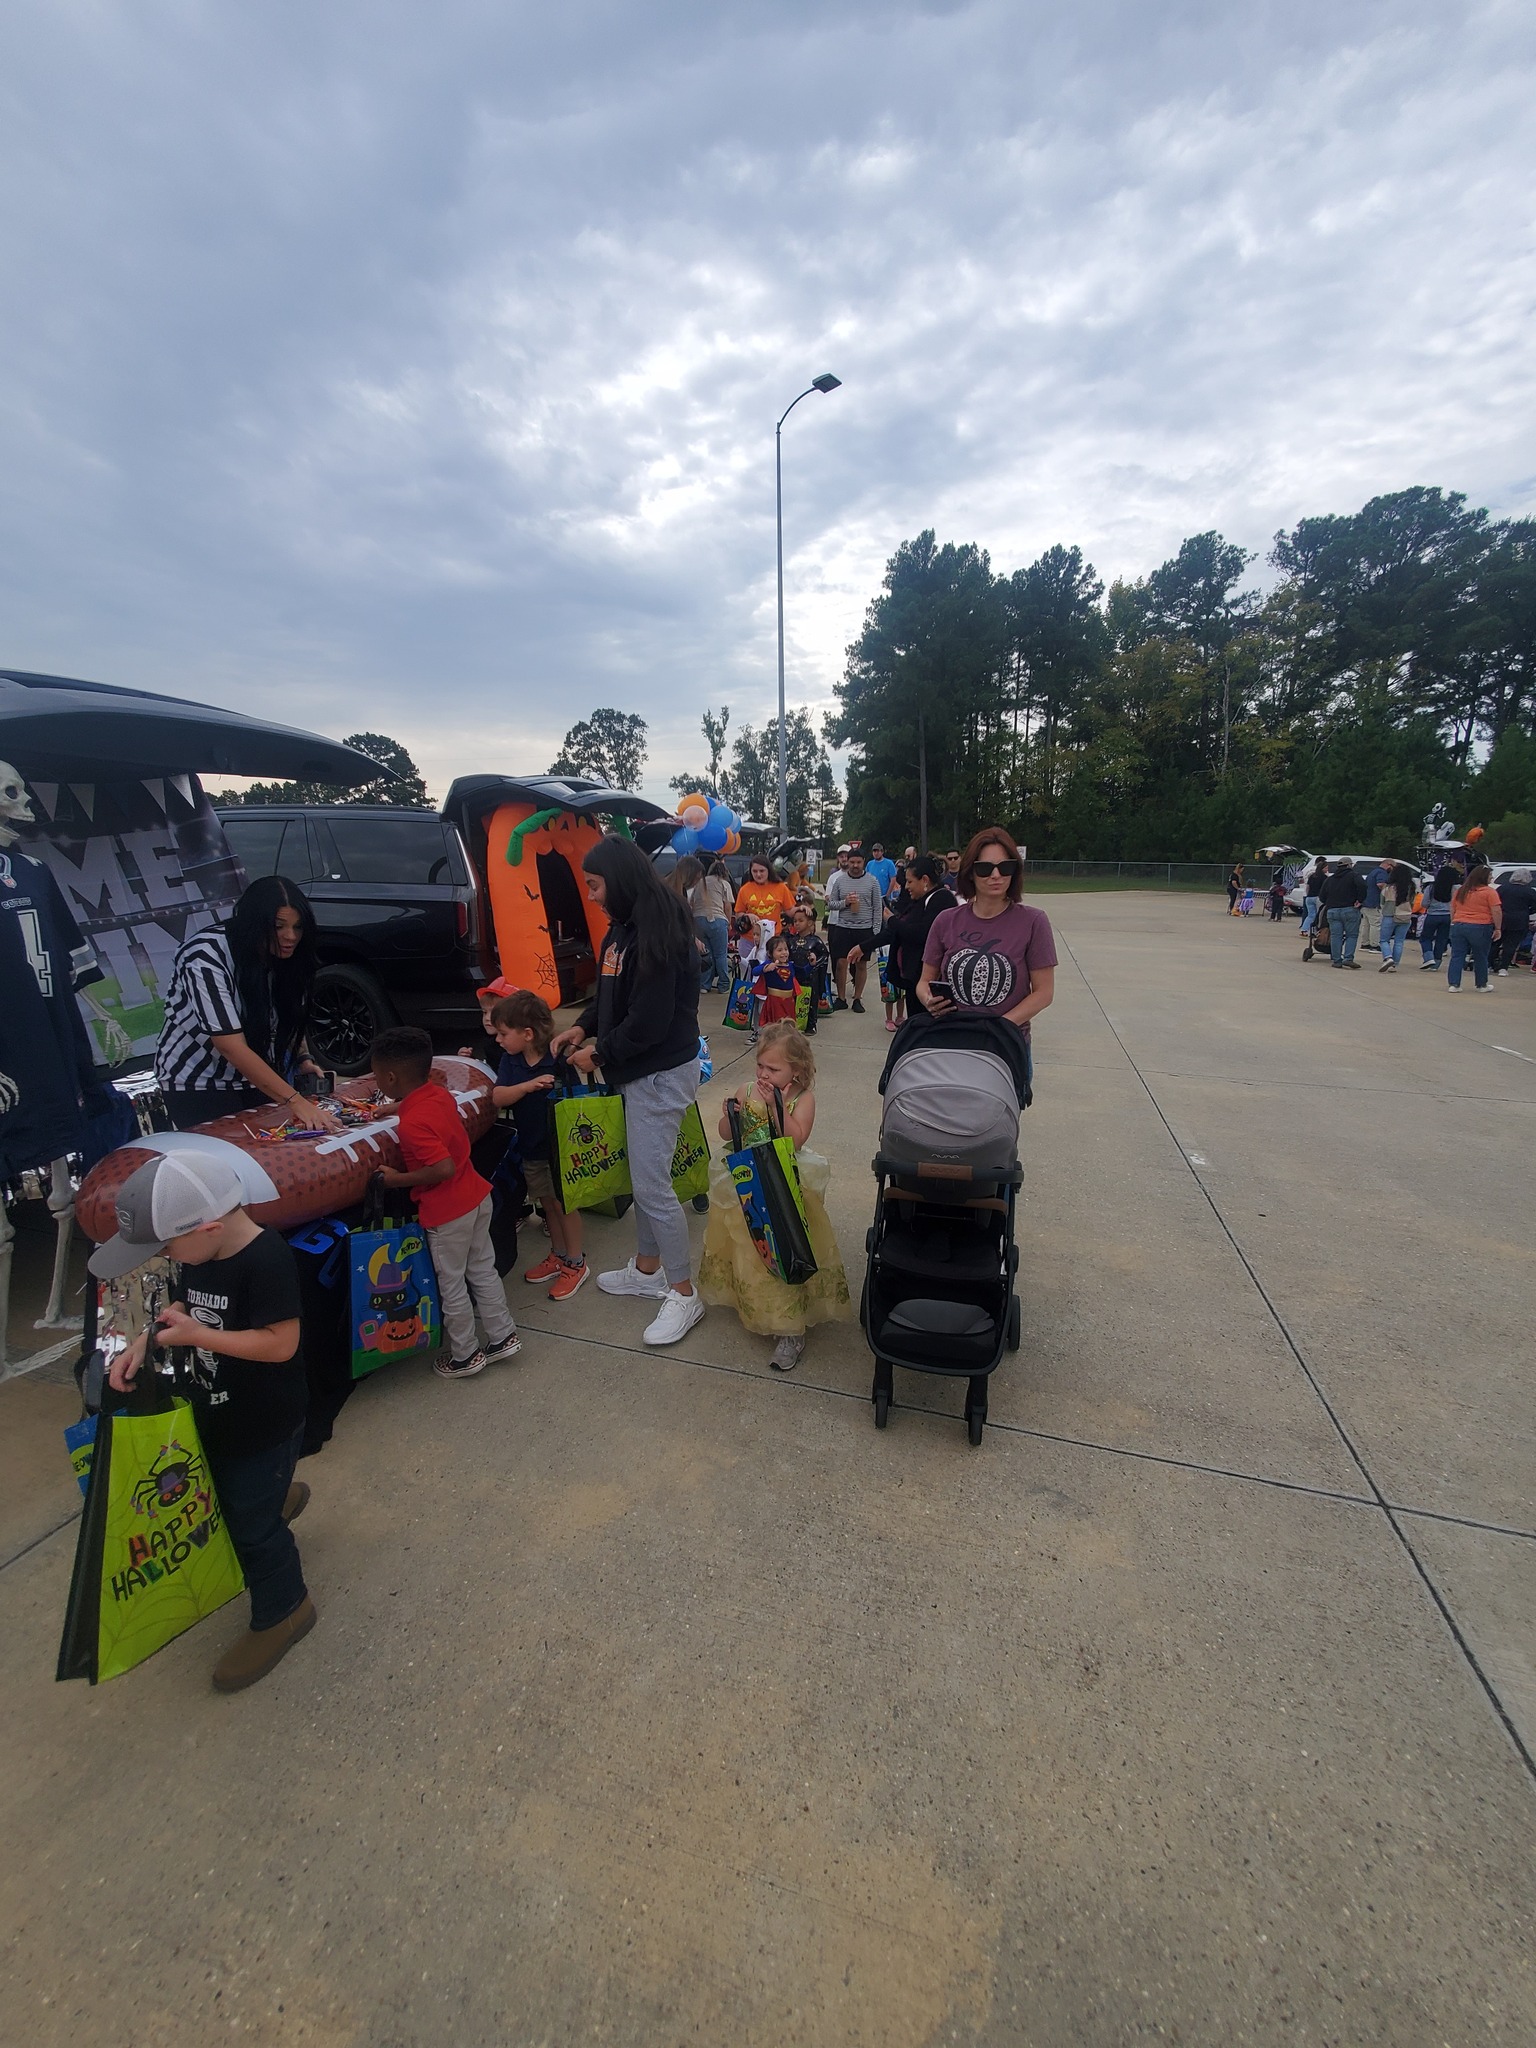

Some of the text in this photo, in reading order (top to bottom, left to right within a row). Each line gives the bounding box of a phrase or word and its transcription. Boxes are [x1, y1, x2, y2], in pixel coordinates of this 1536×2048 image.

[564, 1148, 626, 1185] HALLOWEEN
[570, 1141, 609, 1167] HAPPY
[670, 1145, 705, 1179] LLOWEEN
[671, 1142, 690, 1168] APPY
[187, 1288, 229, 1310] TORNADO
[128, 1483, 212, 1567] HAPPY
[111, 1498, 222, 1601] HALLOWEE
